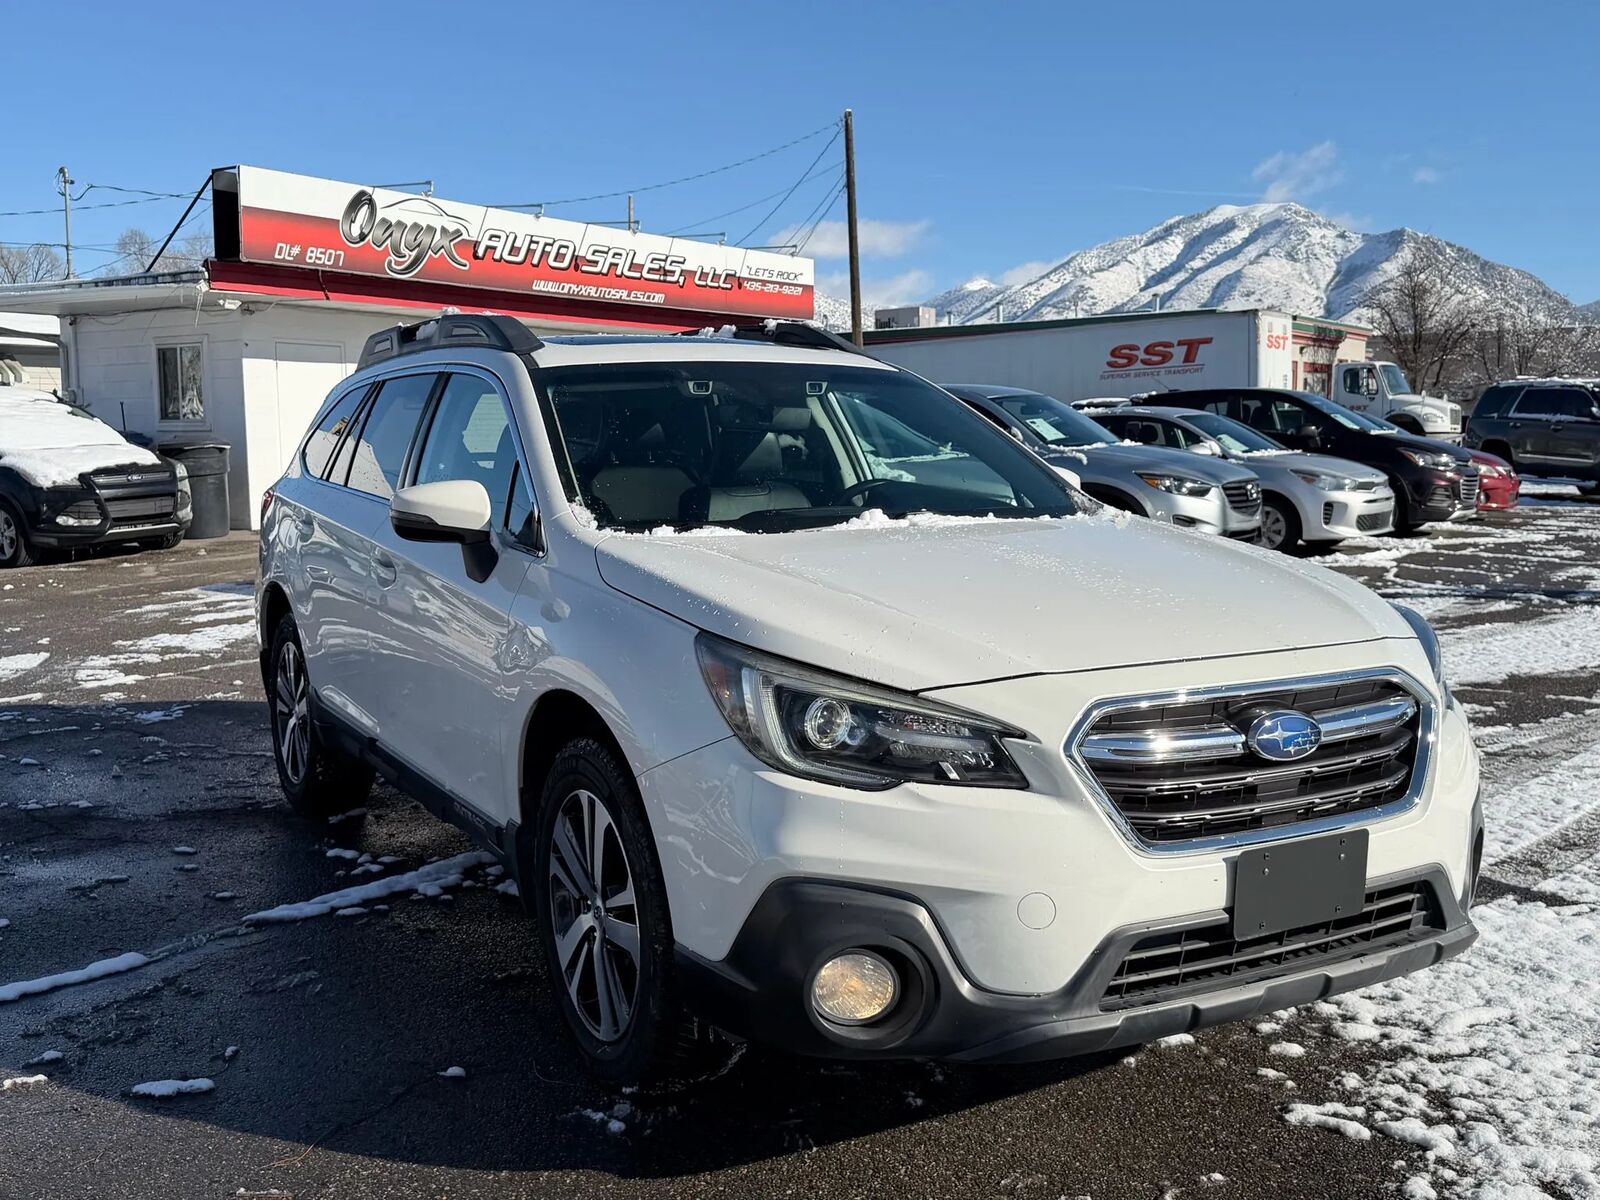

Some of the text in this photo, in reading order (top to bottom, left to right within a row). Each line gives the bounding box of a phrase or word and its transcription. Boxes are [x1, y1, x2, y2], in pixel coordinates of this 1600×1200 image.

[340, 189, 737, 290] Onyx AUTO SALES, LLC
[274, 243, 345, 267] DL# 8507
[743, 280, 803, 295] 435-213-9221
[1266, 334, 1289, 350] SST
[1106, 337, 1214, 369] SST
[1100, 366, 1205, 381] SUPERIOR SERVICE TRANSPORT
